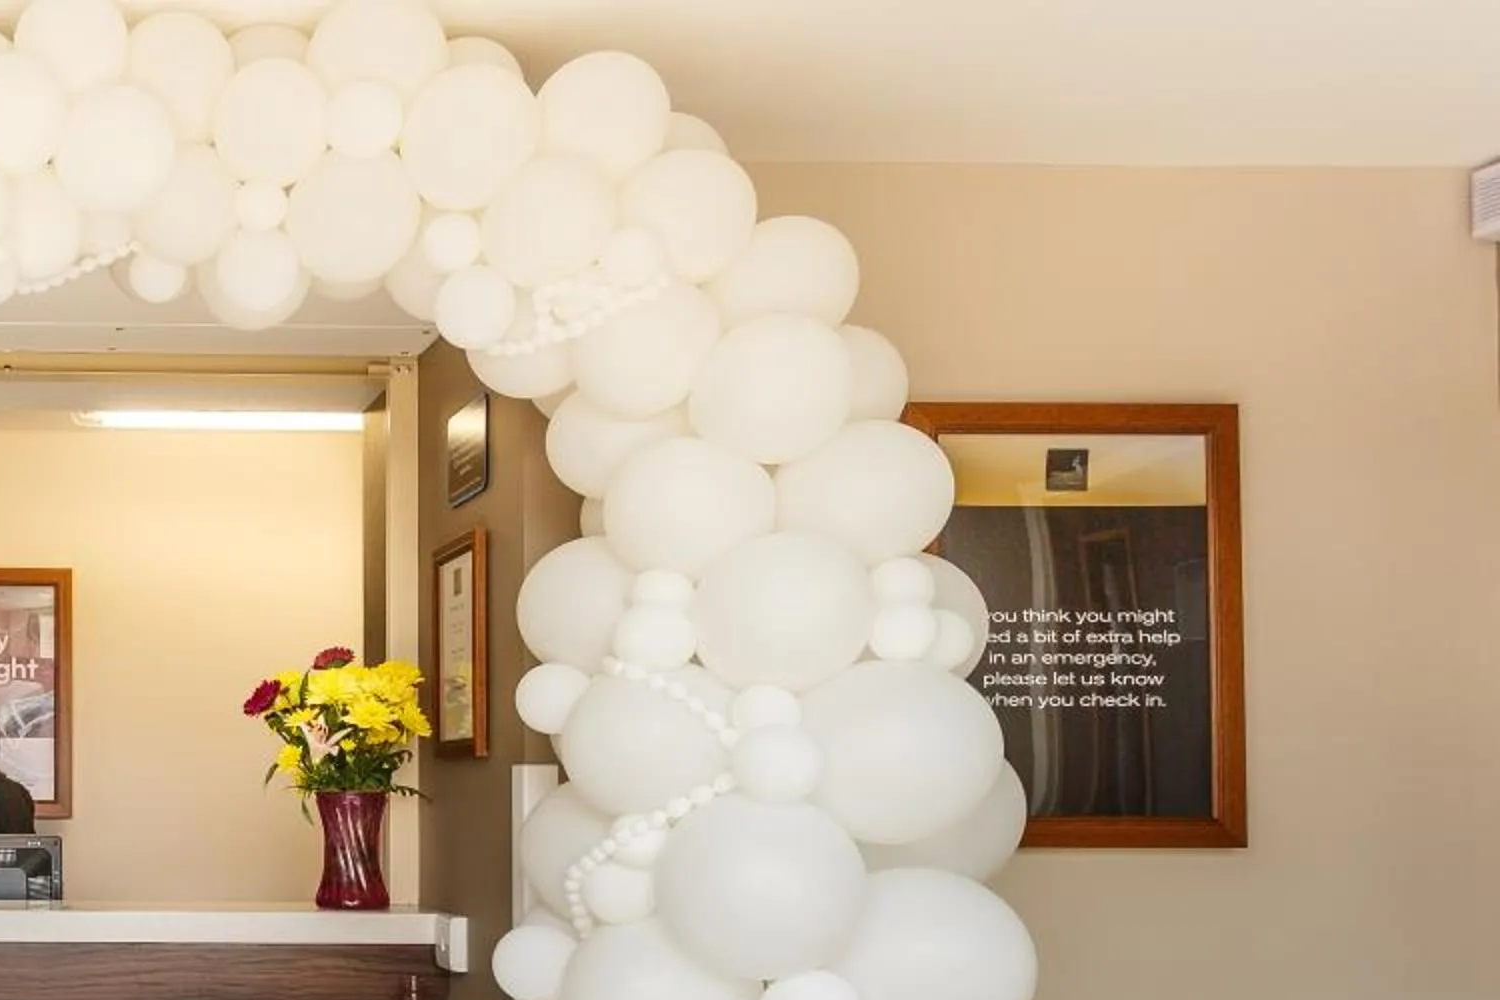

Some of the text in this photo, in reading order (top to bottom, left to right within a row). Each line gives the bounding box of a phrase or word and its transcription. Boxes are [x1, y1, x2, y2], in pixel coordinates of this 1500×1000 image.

[1022, 608, 1071, 623] think
[1075, 611, 1111, 625] you
[1117, 608, 1175, 626] might
[987, 630, 1181, 646] ed a bit of extra help
[989, 650, 1157, 668] in an emergency,
[983, 671, 1165, 688] please let us know
[1037, 695, 1074, 709] you
[1079, 692, 1141, 707] check
[1145, 692, 1167, 707] in.
